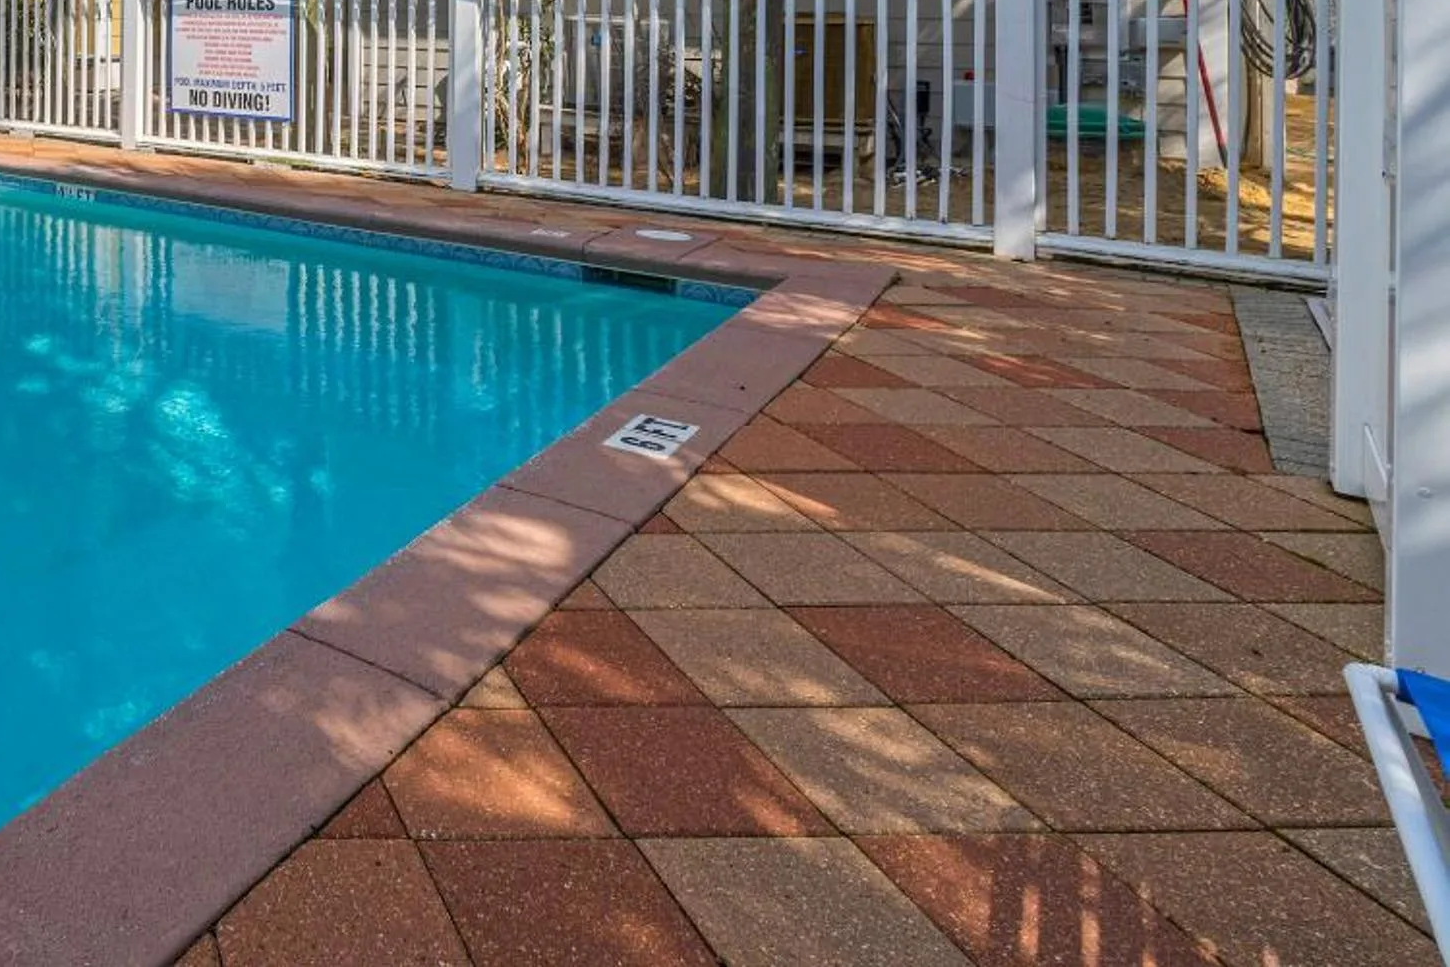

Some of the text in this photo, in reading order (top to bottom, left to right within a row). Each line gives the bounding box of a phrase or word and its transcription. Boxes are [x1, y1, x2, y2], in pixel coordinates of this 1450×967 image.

[266, 83, 287, 93] FEET
[189, 89, 270, 112] NO DIVING!
[620, 436, 666, 451] 6
